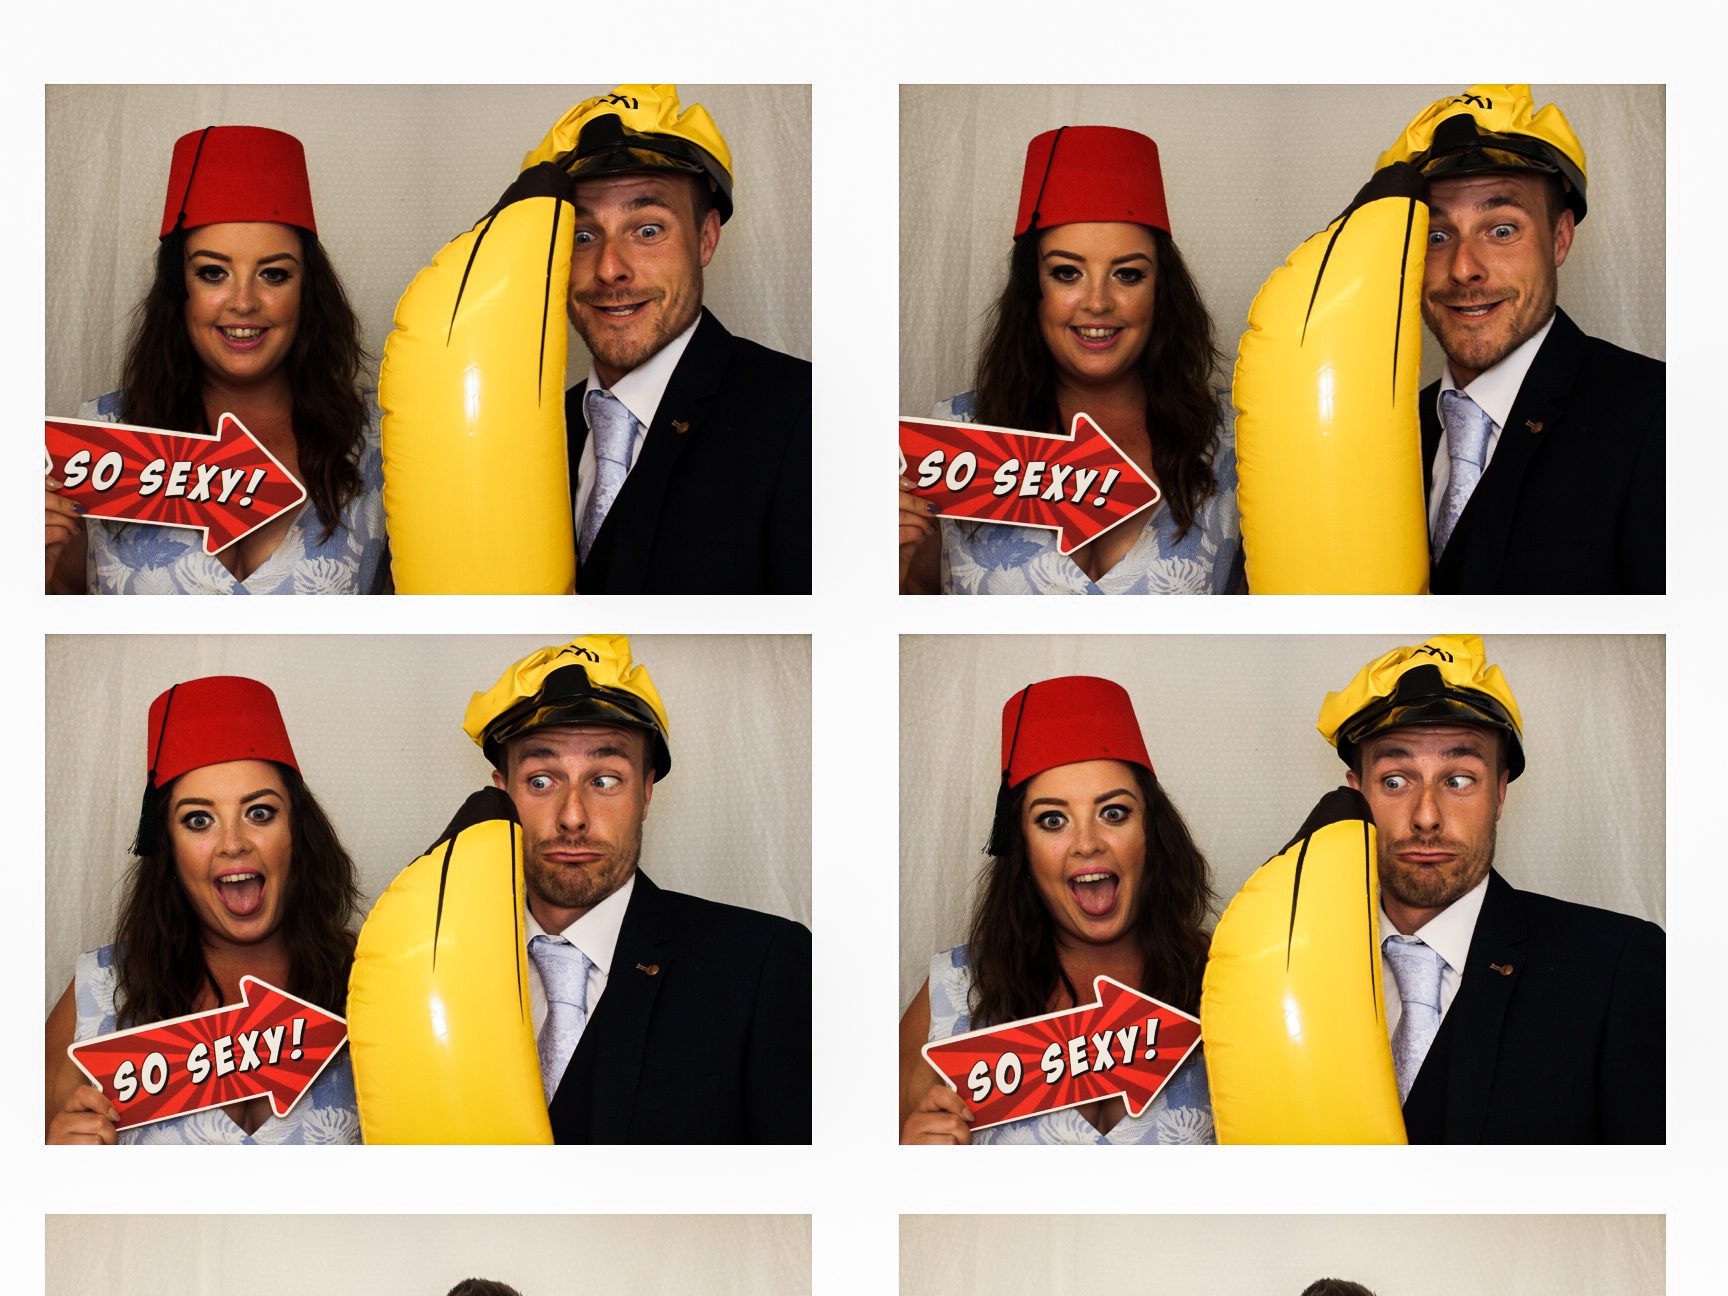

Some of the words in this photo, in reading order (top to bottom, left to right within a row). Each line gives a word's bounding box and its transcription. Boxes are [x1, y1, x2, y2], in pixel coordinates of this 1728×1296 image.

[63, 449, 124, 491] SO
[138, 457, 266, 507] SEXY!
[917, 449, 978, 491] SO
[992, 457, 1120, 507] SEXY!
[113, 1051, 169, 1103] SO
[187, 1018, 307, 1084] SEXY!
[967, 1051, 1023, 1103] SO
[1041, 1018, 1161, 1084] SEXY!
